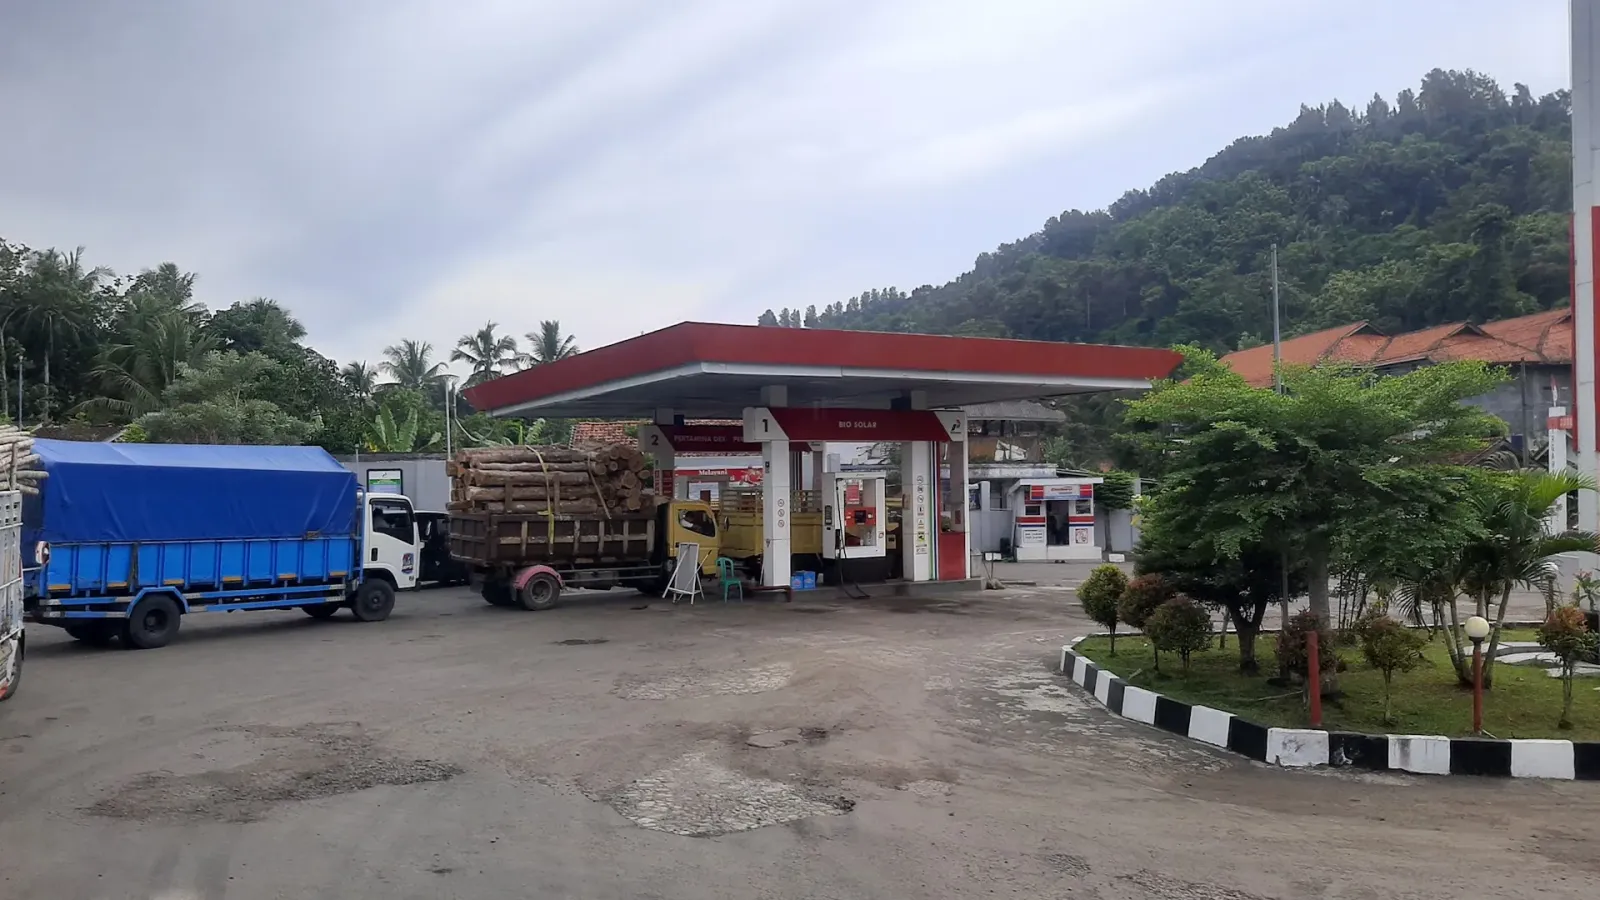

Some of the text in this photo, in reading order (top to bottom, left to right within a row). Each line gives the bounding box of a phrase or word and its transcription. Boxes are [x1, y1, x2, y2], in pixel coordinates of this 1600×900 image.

[762, 419, 769, 433] 1
[838, 420, 852, 428] BIO
[650, 434, 659, 446] 2
[674, 434, 712, 442] PERTAMINA
